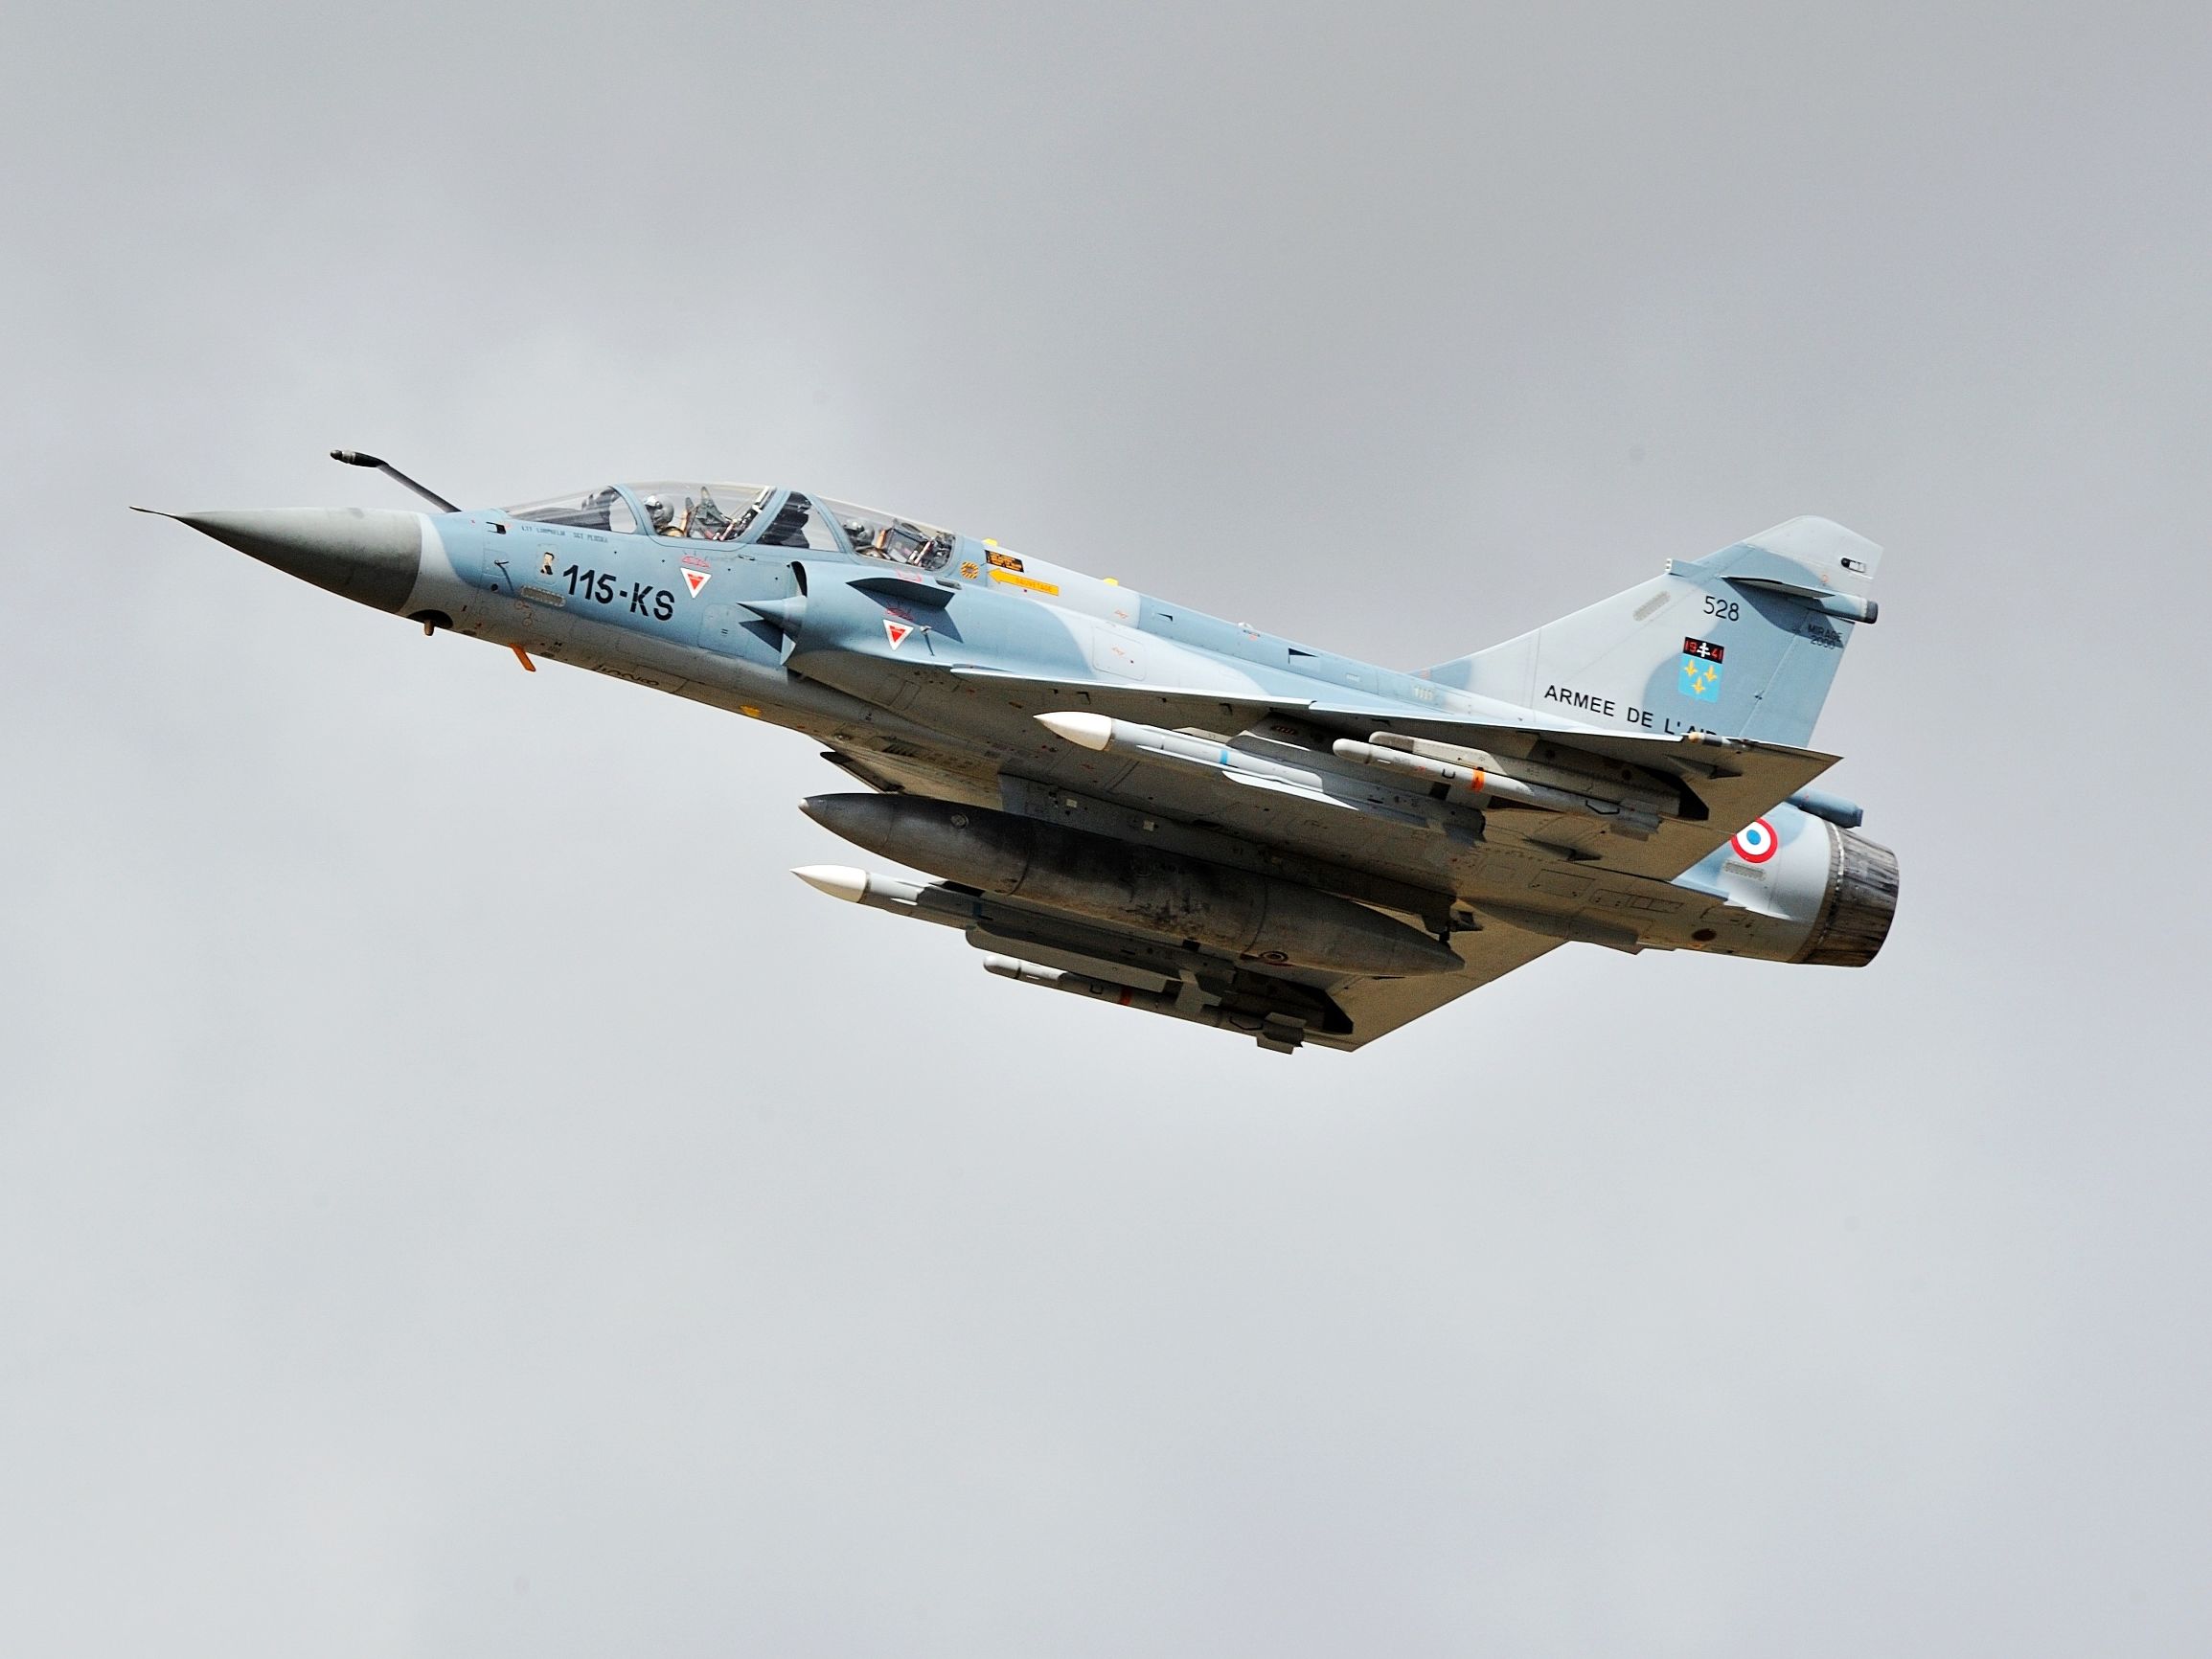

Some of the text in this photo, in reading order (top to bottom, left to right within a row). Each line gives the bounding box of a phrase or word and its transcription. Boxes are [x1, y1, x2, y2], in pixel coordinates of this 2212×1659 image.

[563, 564, 675, 621] 115-KS
[1703, 595, 1740, 622] 528
[1808, 624, 1843, 643] MIRAGE
[1811, 635, 1836, 649] 2000
[1544, 684, 1615, 717] ARMEE
[1627, 707, 1654, 729] DE
